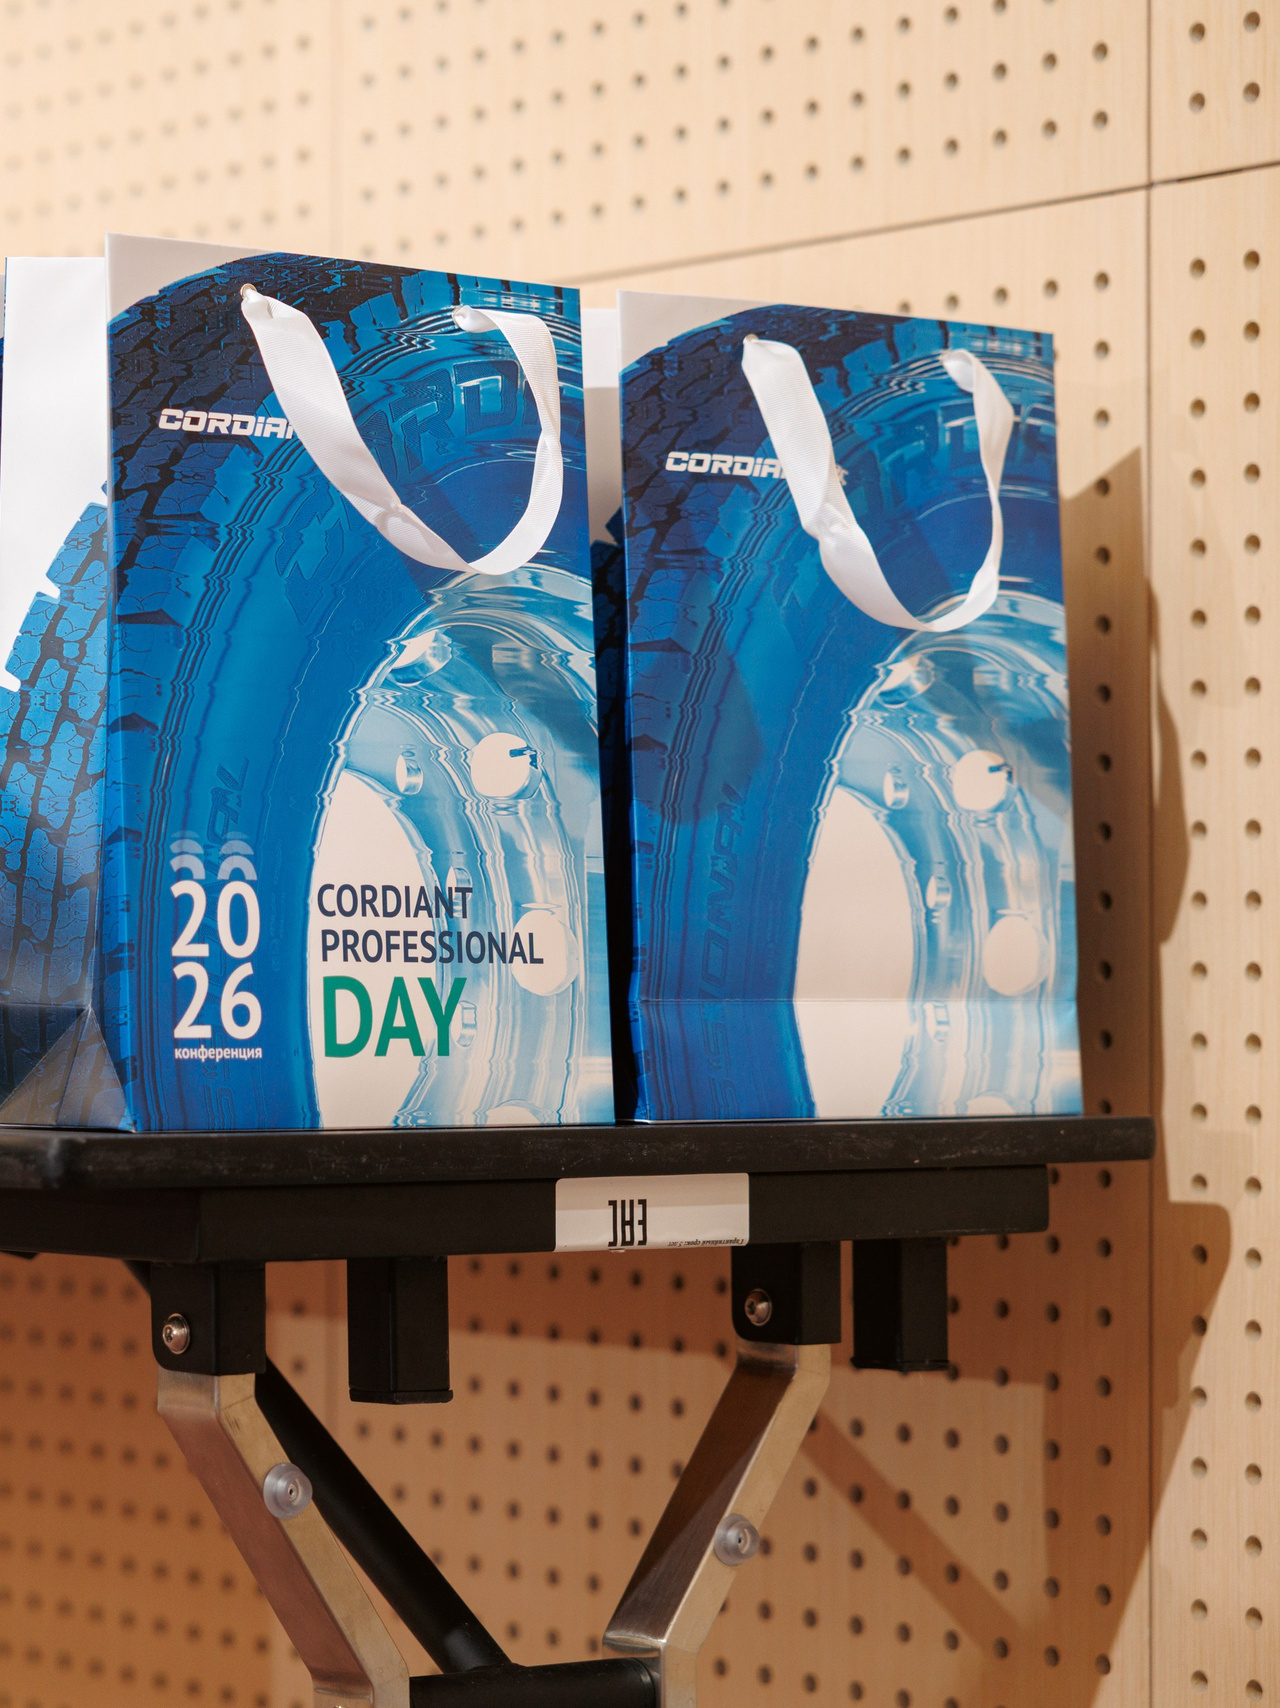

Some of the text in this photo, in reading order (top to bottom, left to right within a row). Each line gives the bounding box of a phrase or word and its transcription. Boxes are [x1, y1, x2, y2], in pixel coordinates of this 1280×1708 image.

[158, 408, 294, 440] CORDIA
[665, 451, 786, 479] CORDIA
[317, 884, 473, 919] CORDIANT
[170, 880, 261, 959] 20
[321, 929, 544, 964] PROFESSIONAL
[172, 961, 262, 1040] 26
[323, 976, 467, 1058] DAY
[174, 1046, 263, 1063] конференция
